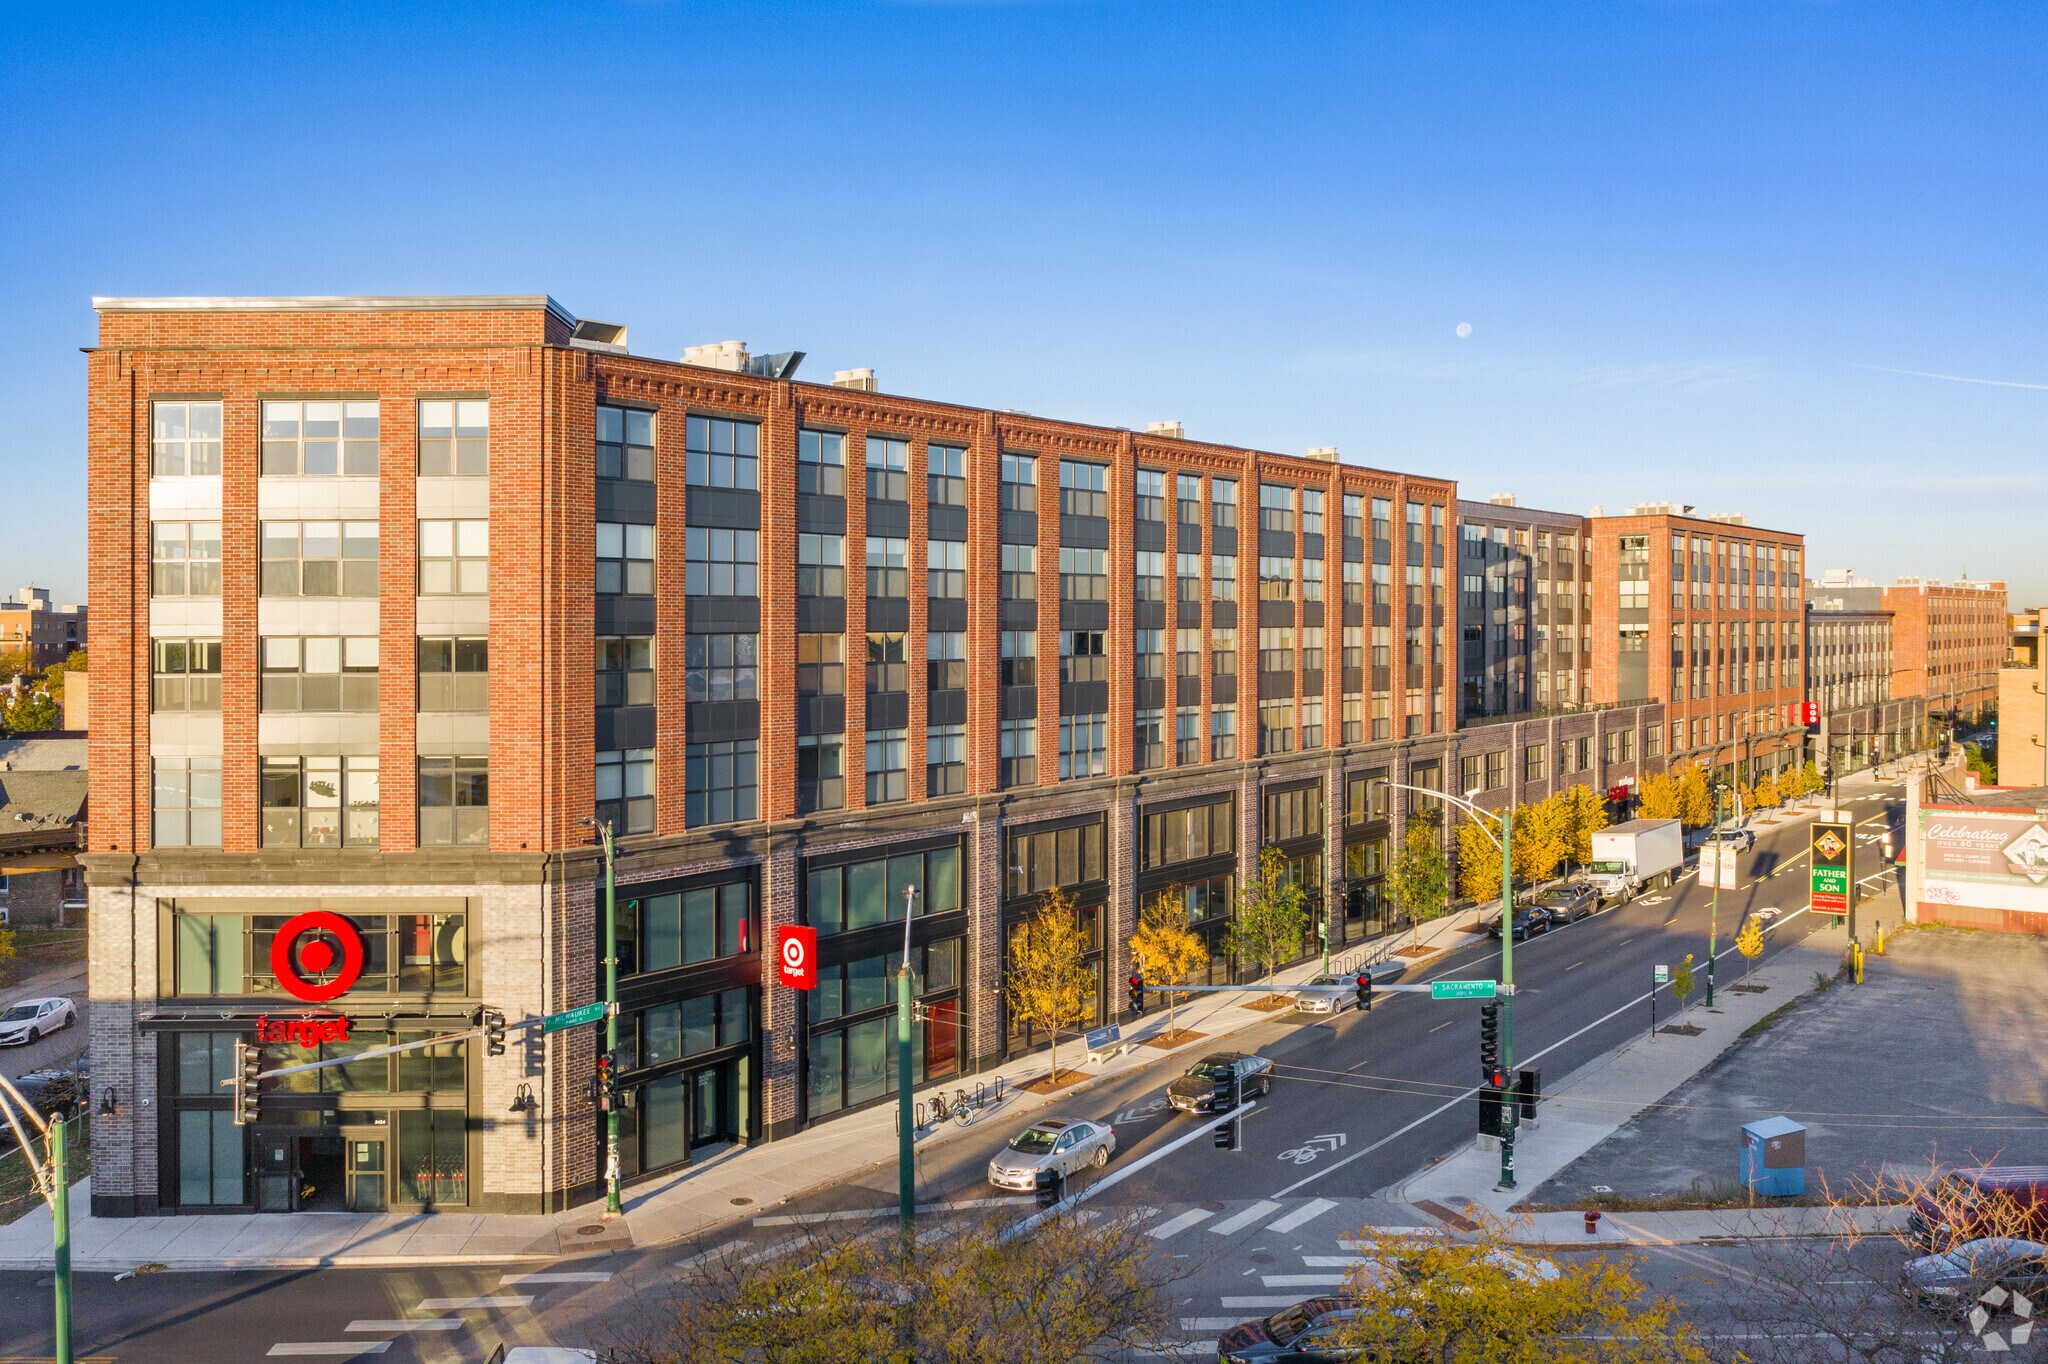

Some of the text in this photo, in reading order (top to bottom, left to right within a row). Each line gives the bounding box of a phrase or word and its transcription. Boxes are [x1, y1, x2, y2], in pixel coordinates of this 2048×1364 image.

[1927, 824, 2009, 845] Celebrating
[1812, 868, 1846, 878] FATHER
[1819, 883, 1840, 892] SON
[783, 965, 805, 977] target
[1442, 983, 1483, 991] SACRAMENTO
[555, 1008, 591, 1022] MILWAUKEE
[256, 1015, 351, 1049] target
